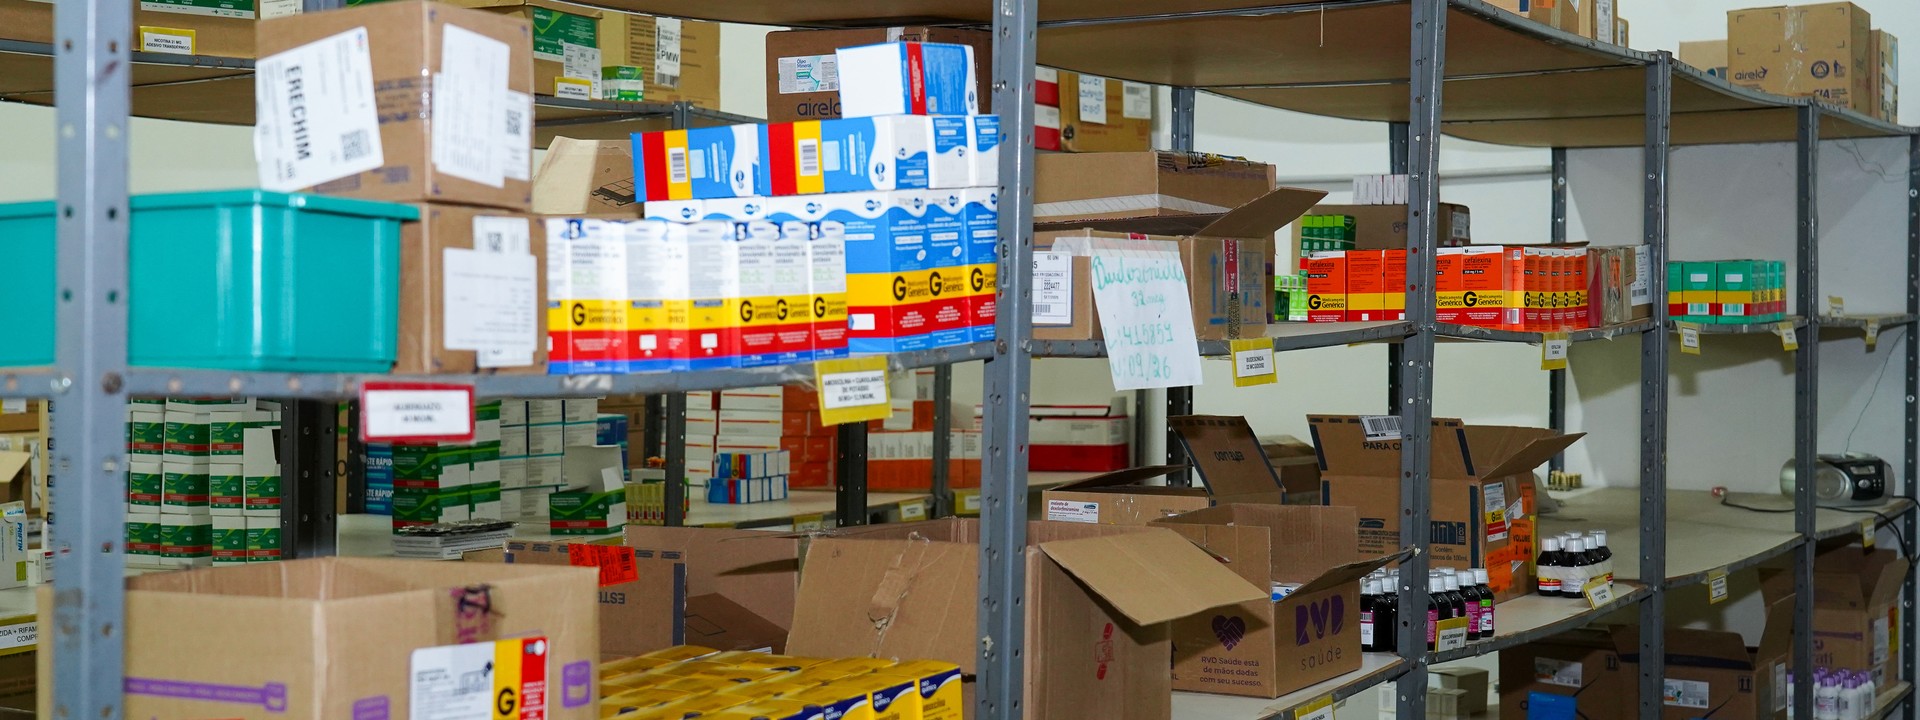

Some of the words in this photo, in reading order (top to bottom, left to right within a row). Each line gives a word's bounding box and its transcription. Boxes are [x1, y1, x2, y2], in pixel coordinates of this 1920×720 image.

[660, 50, 680, 63] PMW
[286, 65, 311, 160] ERECHIM
[893, 276, 906, 301] G
[930, 271, 942, 296] G
[971, 267, 984, 292] G
[814, 297, 826, 318] G
[1308, 294, 1322, 310] G
[1322, 301, 1345, 309] Genérico
[1463, 291, 1478, 307] G
[1524, 291, 1531, 308] G
[1538, 292, 1545, 308] G
[1551, 292, 1558, 308] G
[572, 303, 585, 326] G
[740, 300, 753, 322] G
[777, 299, 788, 320] G
[1362, 441, 1391, 451] PARA
[1296, 594, 1344, 647] RVD
[1201, 656, 1217, 664] RVD
[1218, 656, 1243, 666] Saúde
[1243, 658, 1260, 667] está
[1300, 646, 1342, 671] saúde
[1203, 666, 1212, 674] de
[1214, 667, 1235, 675] mãos
[1235, 668, 1259, 677] dadas
[1199, 676, 1216, 684] com
[1231, 679, 1263, 687] sucesso.
[498, 688, 516, 716] G
